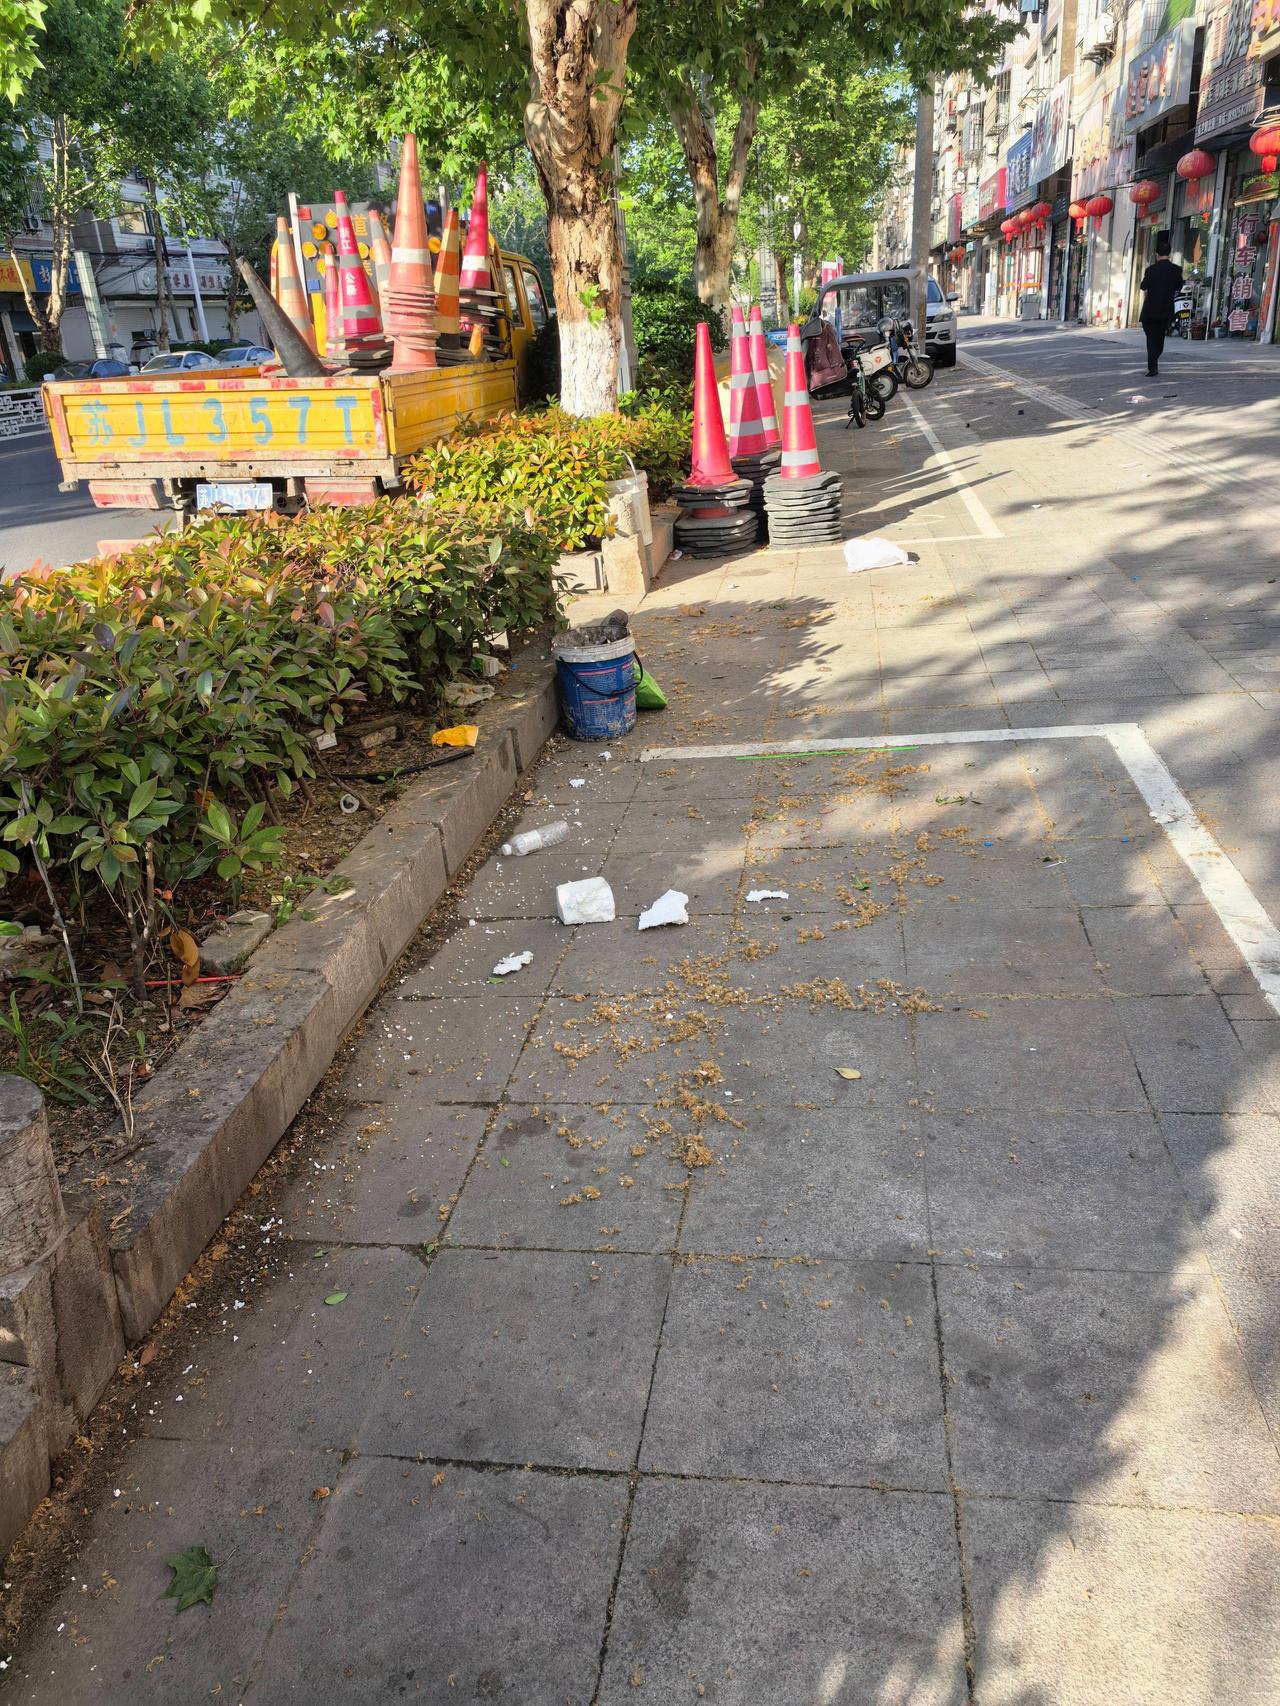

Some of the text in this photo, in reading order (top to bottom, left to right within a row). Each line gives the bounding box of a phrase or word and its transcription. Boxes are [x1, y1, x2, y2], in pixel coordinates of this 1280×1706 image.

[1227, 213, 1259, 332] 行车销售
[82, 395, 358, 448] 苏JL357T
